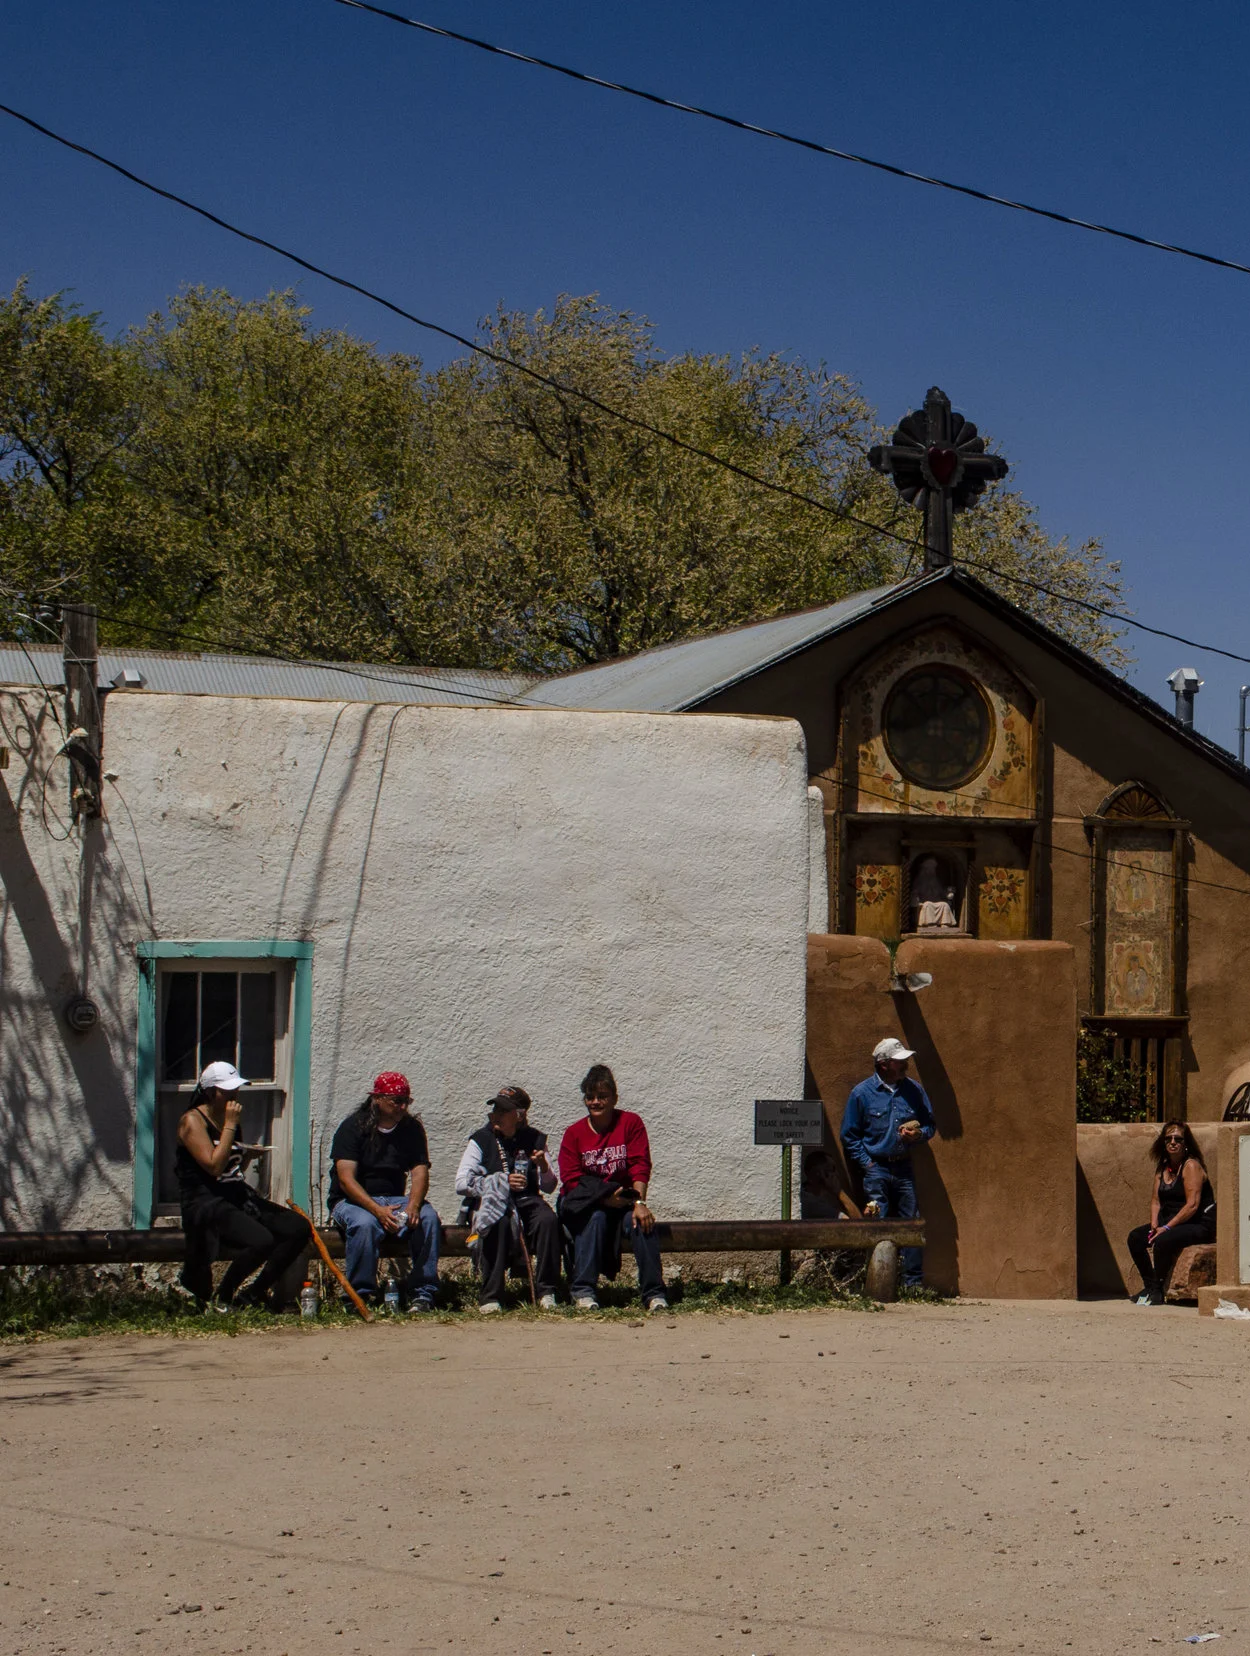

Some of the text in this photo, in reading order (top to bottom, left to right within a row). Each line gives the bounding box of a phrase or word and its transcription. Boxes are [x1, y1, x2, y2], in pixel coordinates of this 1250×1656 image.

[758, 1119, 777, 1127] PLEASE
[779, 1119, 792, 1127] LOCK
[794, 1119, 808, 1127] YOUR
